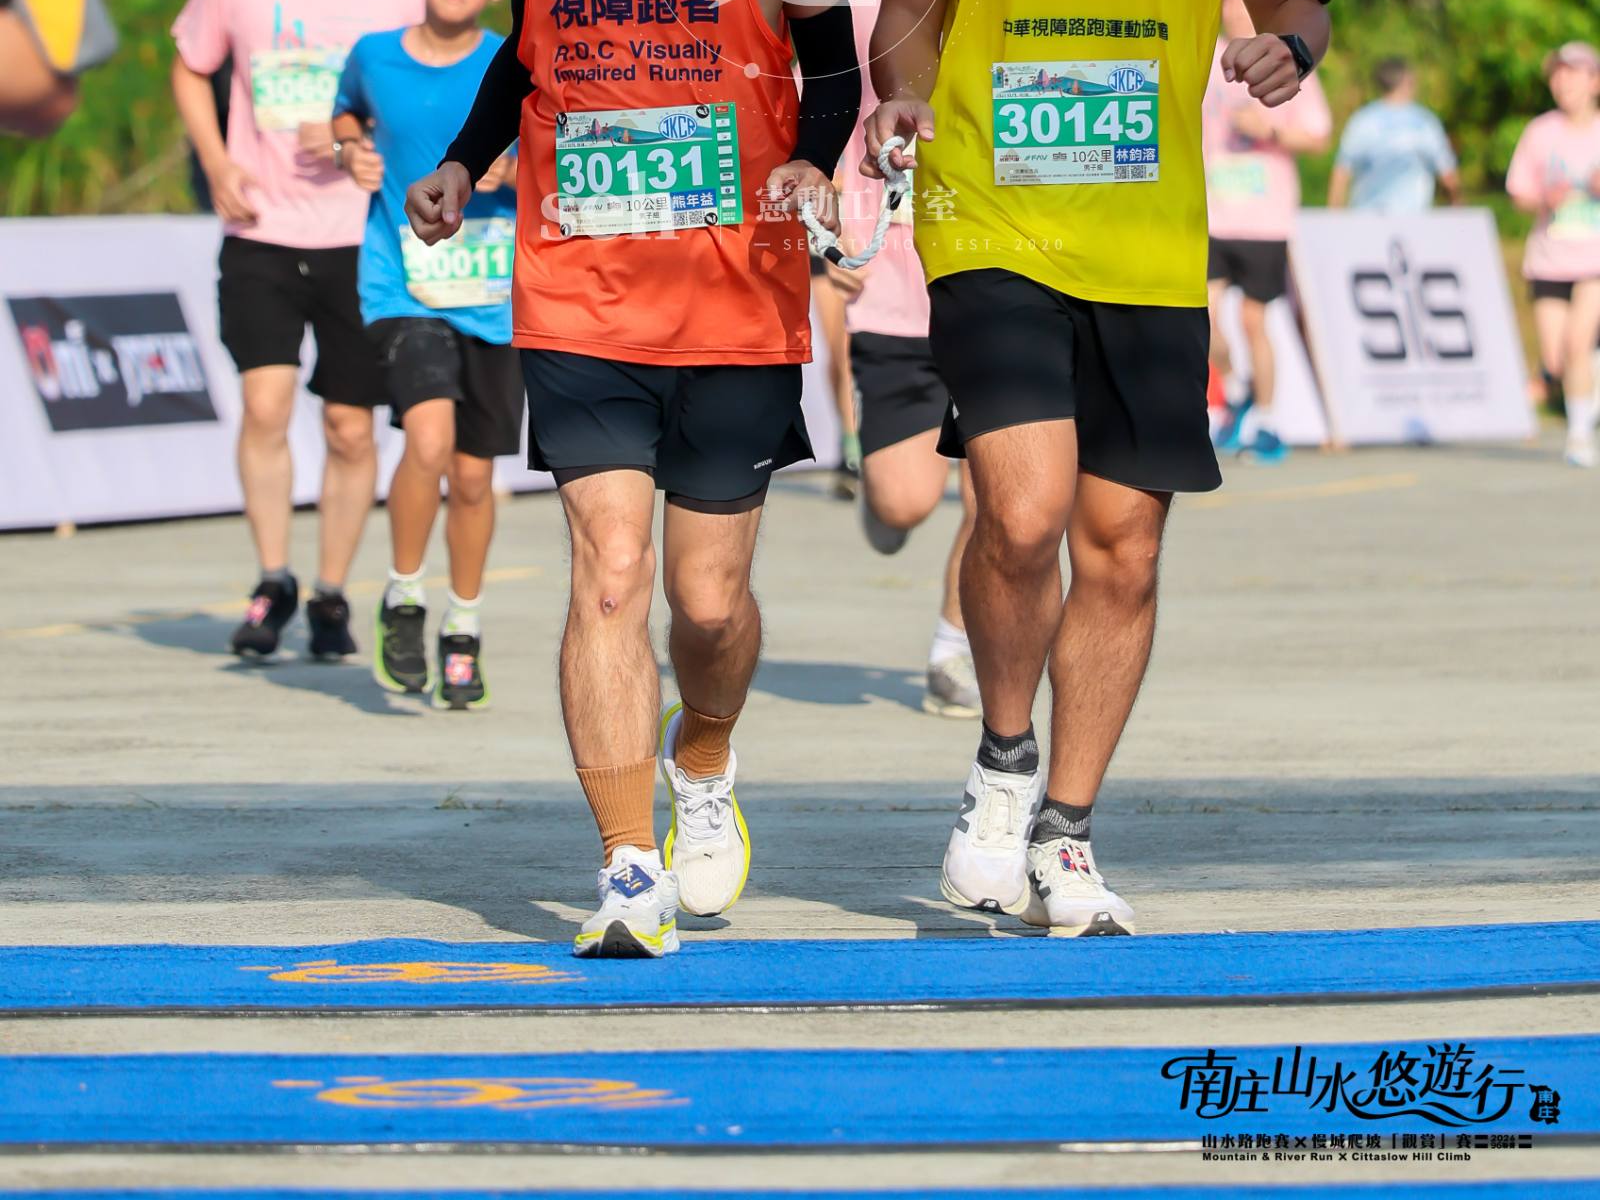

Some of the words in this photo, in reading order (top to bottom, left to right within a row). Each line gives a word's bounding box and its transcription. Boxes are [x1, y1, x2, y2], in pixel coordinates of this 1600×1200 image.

[1003, 17, 1169, 41] 中華視障路跑運動協會
[554, 40, 614, 64] R.O.C
[629, 39, 722, 65] Visually
[554, 64, 636, 86] Impaired
[649, 64, 723, 82] Runner
[1109, 69, 1144, 93] JKCR
[659, 115, 698, 139] JKCR
[998, 100, 1153, 145] 30145
[1071, 149, 1112, 163] 10公里
[560, 145, 704, 195] 30131
[626, 196, 669, 212] 10公里
